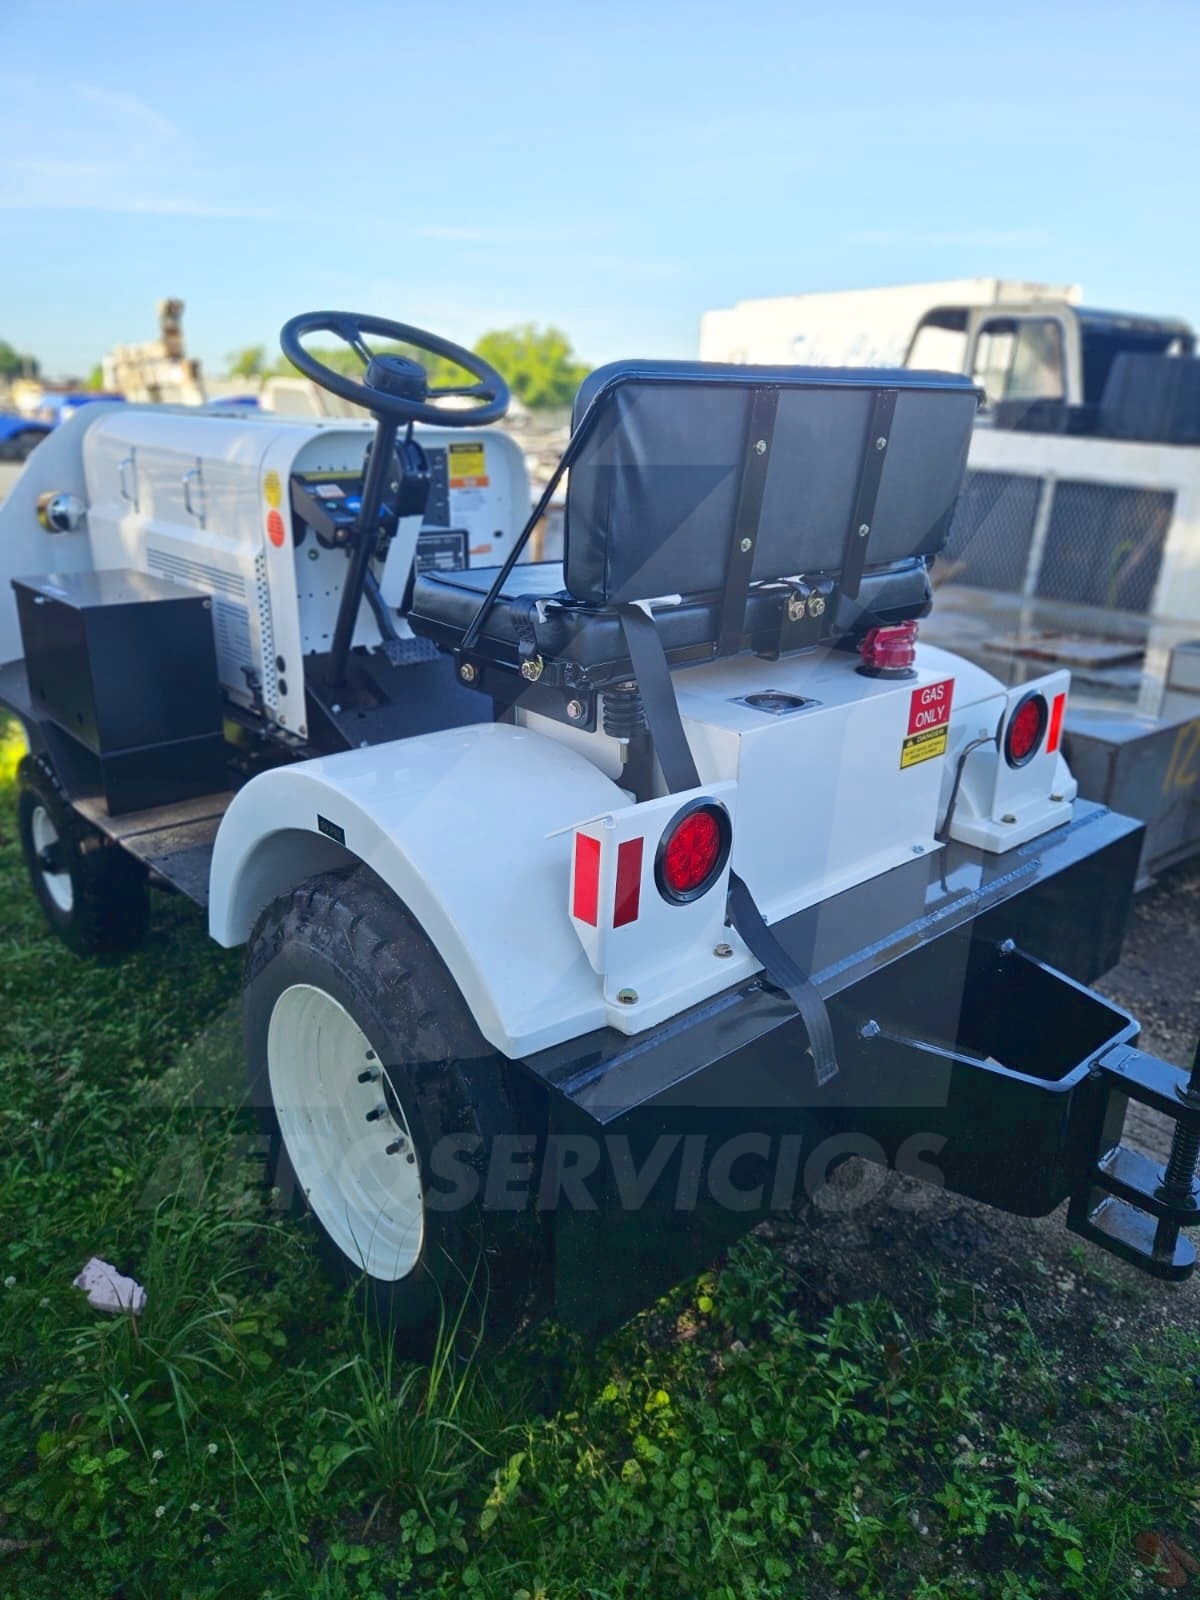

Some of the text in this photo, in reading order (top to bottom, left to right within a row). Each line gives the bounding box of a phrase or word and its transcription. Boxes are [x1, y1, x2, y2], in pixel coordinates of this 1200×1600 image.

[922, 685, 945, 704] GAS
[916, 706, 945, 728] ONLY
[917, 729, 945, 743] DANGER
